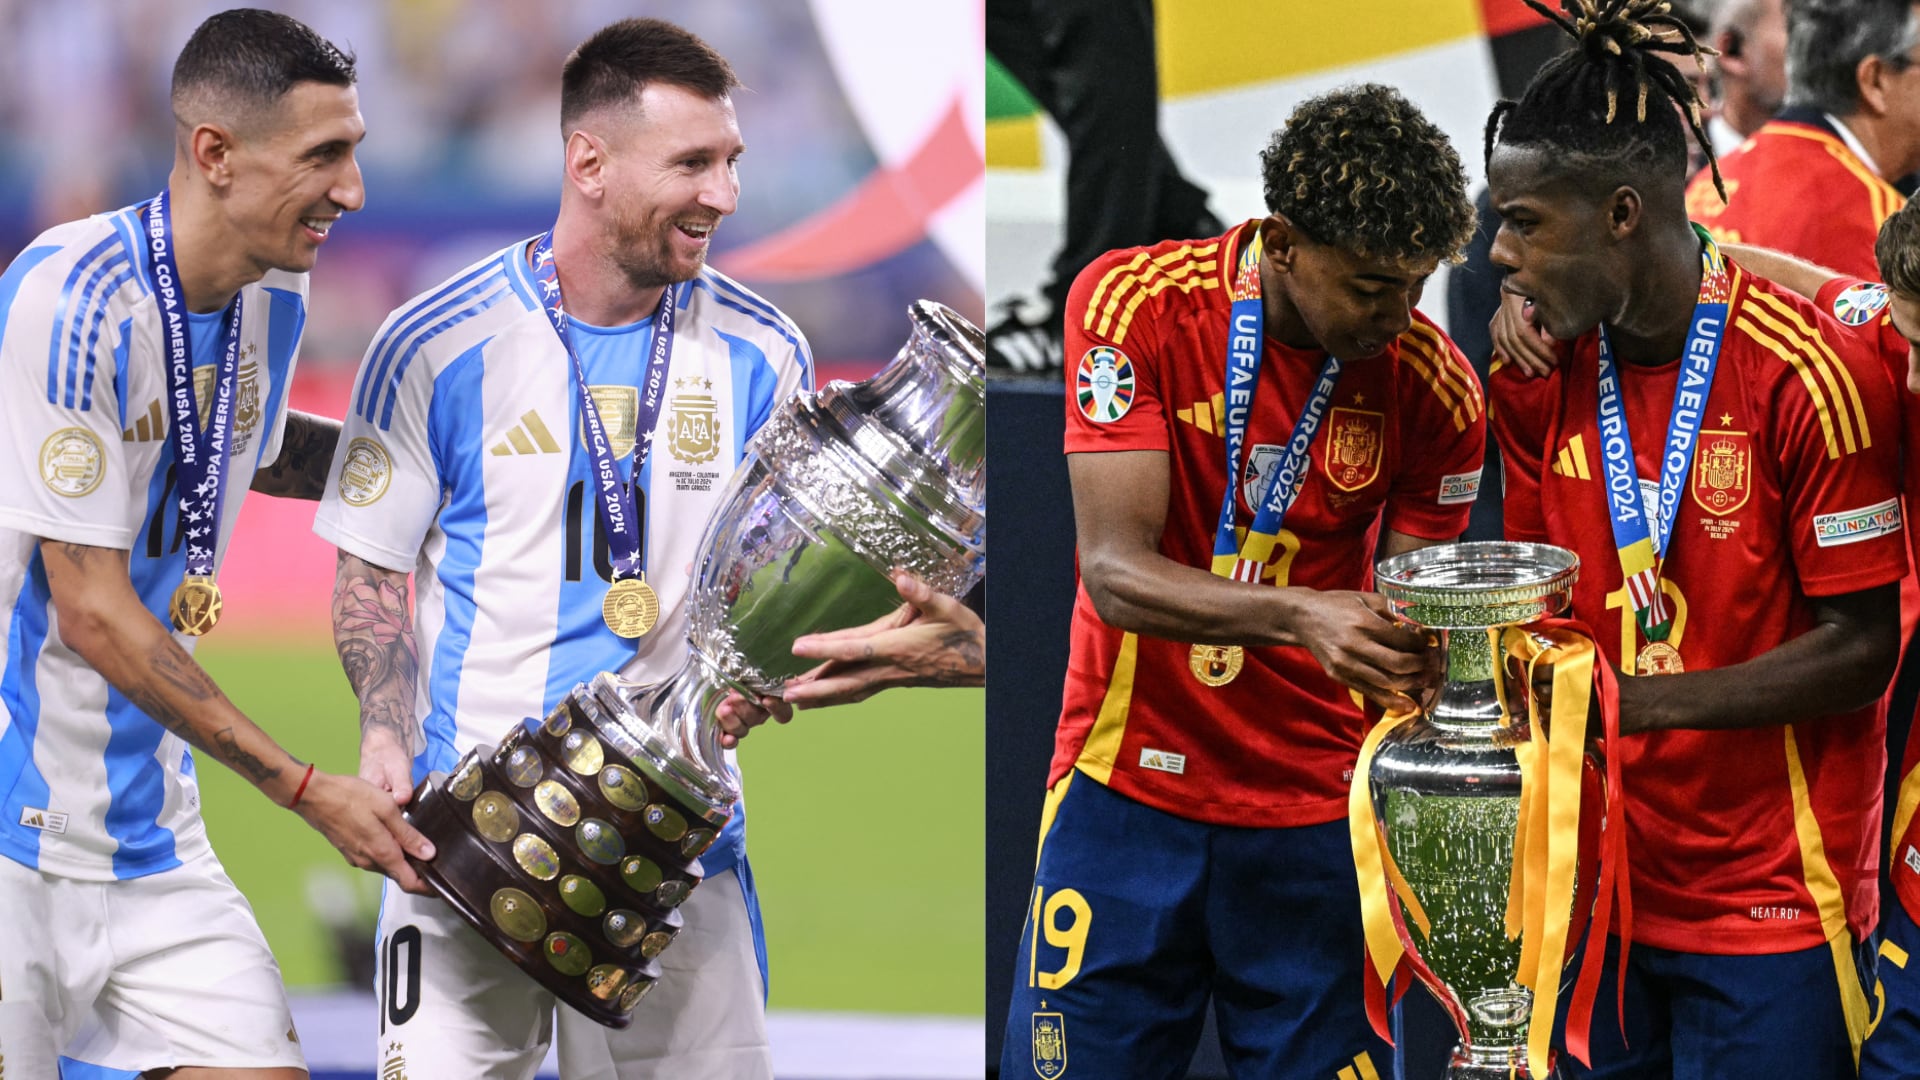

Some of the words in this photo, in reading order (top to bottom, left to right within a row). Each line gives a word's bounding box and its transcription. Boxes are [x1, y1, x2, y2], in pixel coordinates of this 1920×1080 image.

[156, 264, 177, 310] COPA
[167, 311, 188, 386] AMERICA
[653, 336, 668, 365] USA
[175, 388, 191, 421] USA
[212, 376, 232, 451] AMERICA
[224, 341, 236, 372] USA
[645, 371, 663, 409] 2024
[180, 423, 196, 463] 2024
[679, 412, 710, 445] AFA
[599, 459, 615, 492] USA
[606, 493, 624, 533] 2024
[1816, 515, 1837, 526] UEFA
[1818, 508, 1899, 536] FOUNDATION
[1751, 906, 1800, 920] HEAT.RDY
[1029, 885, 1092, 990] 19
[380, 924, 421, 1037] 10
